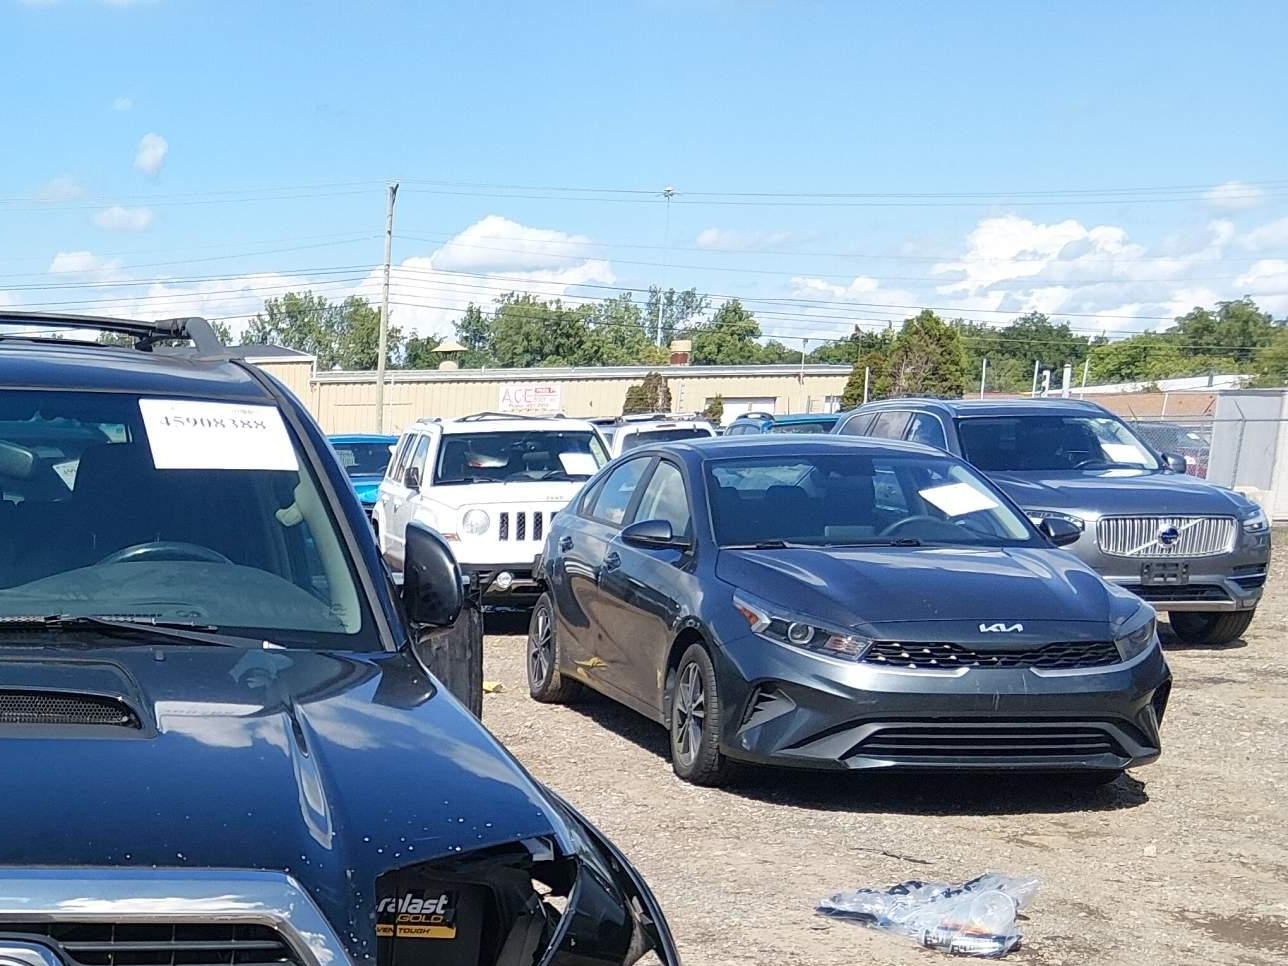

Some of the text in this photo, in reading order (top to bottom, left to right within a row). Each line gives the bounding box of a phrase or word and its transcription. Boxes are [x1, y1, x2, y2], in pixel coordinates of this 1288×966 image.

[160, 415, 267, 431] 45908388
[376, 893, 448, 914] ralast
[396, 914, 444, 923] GOLD
